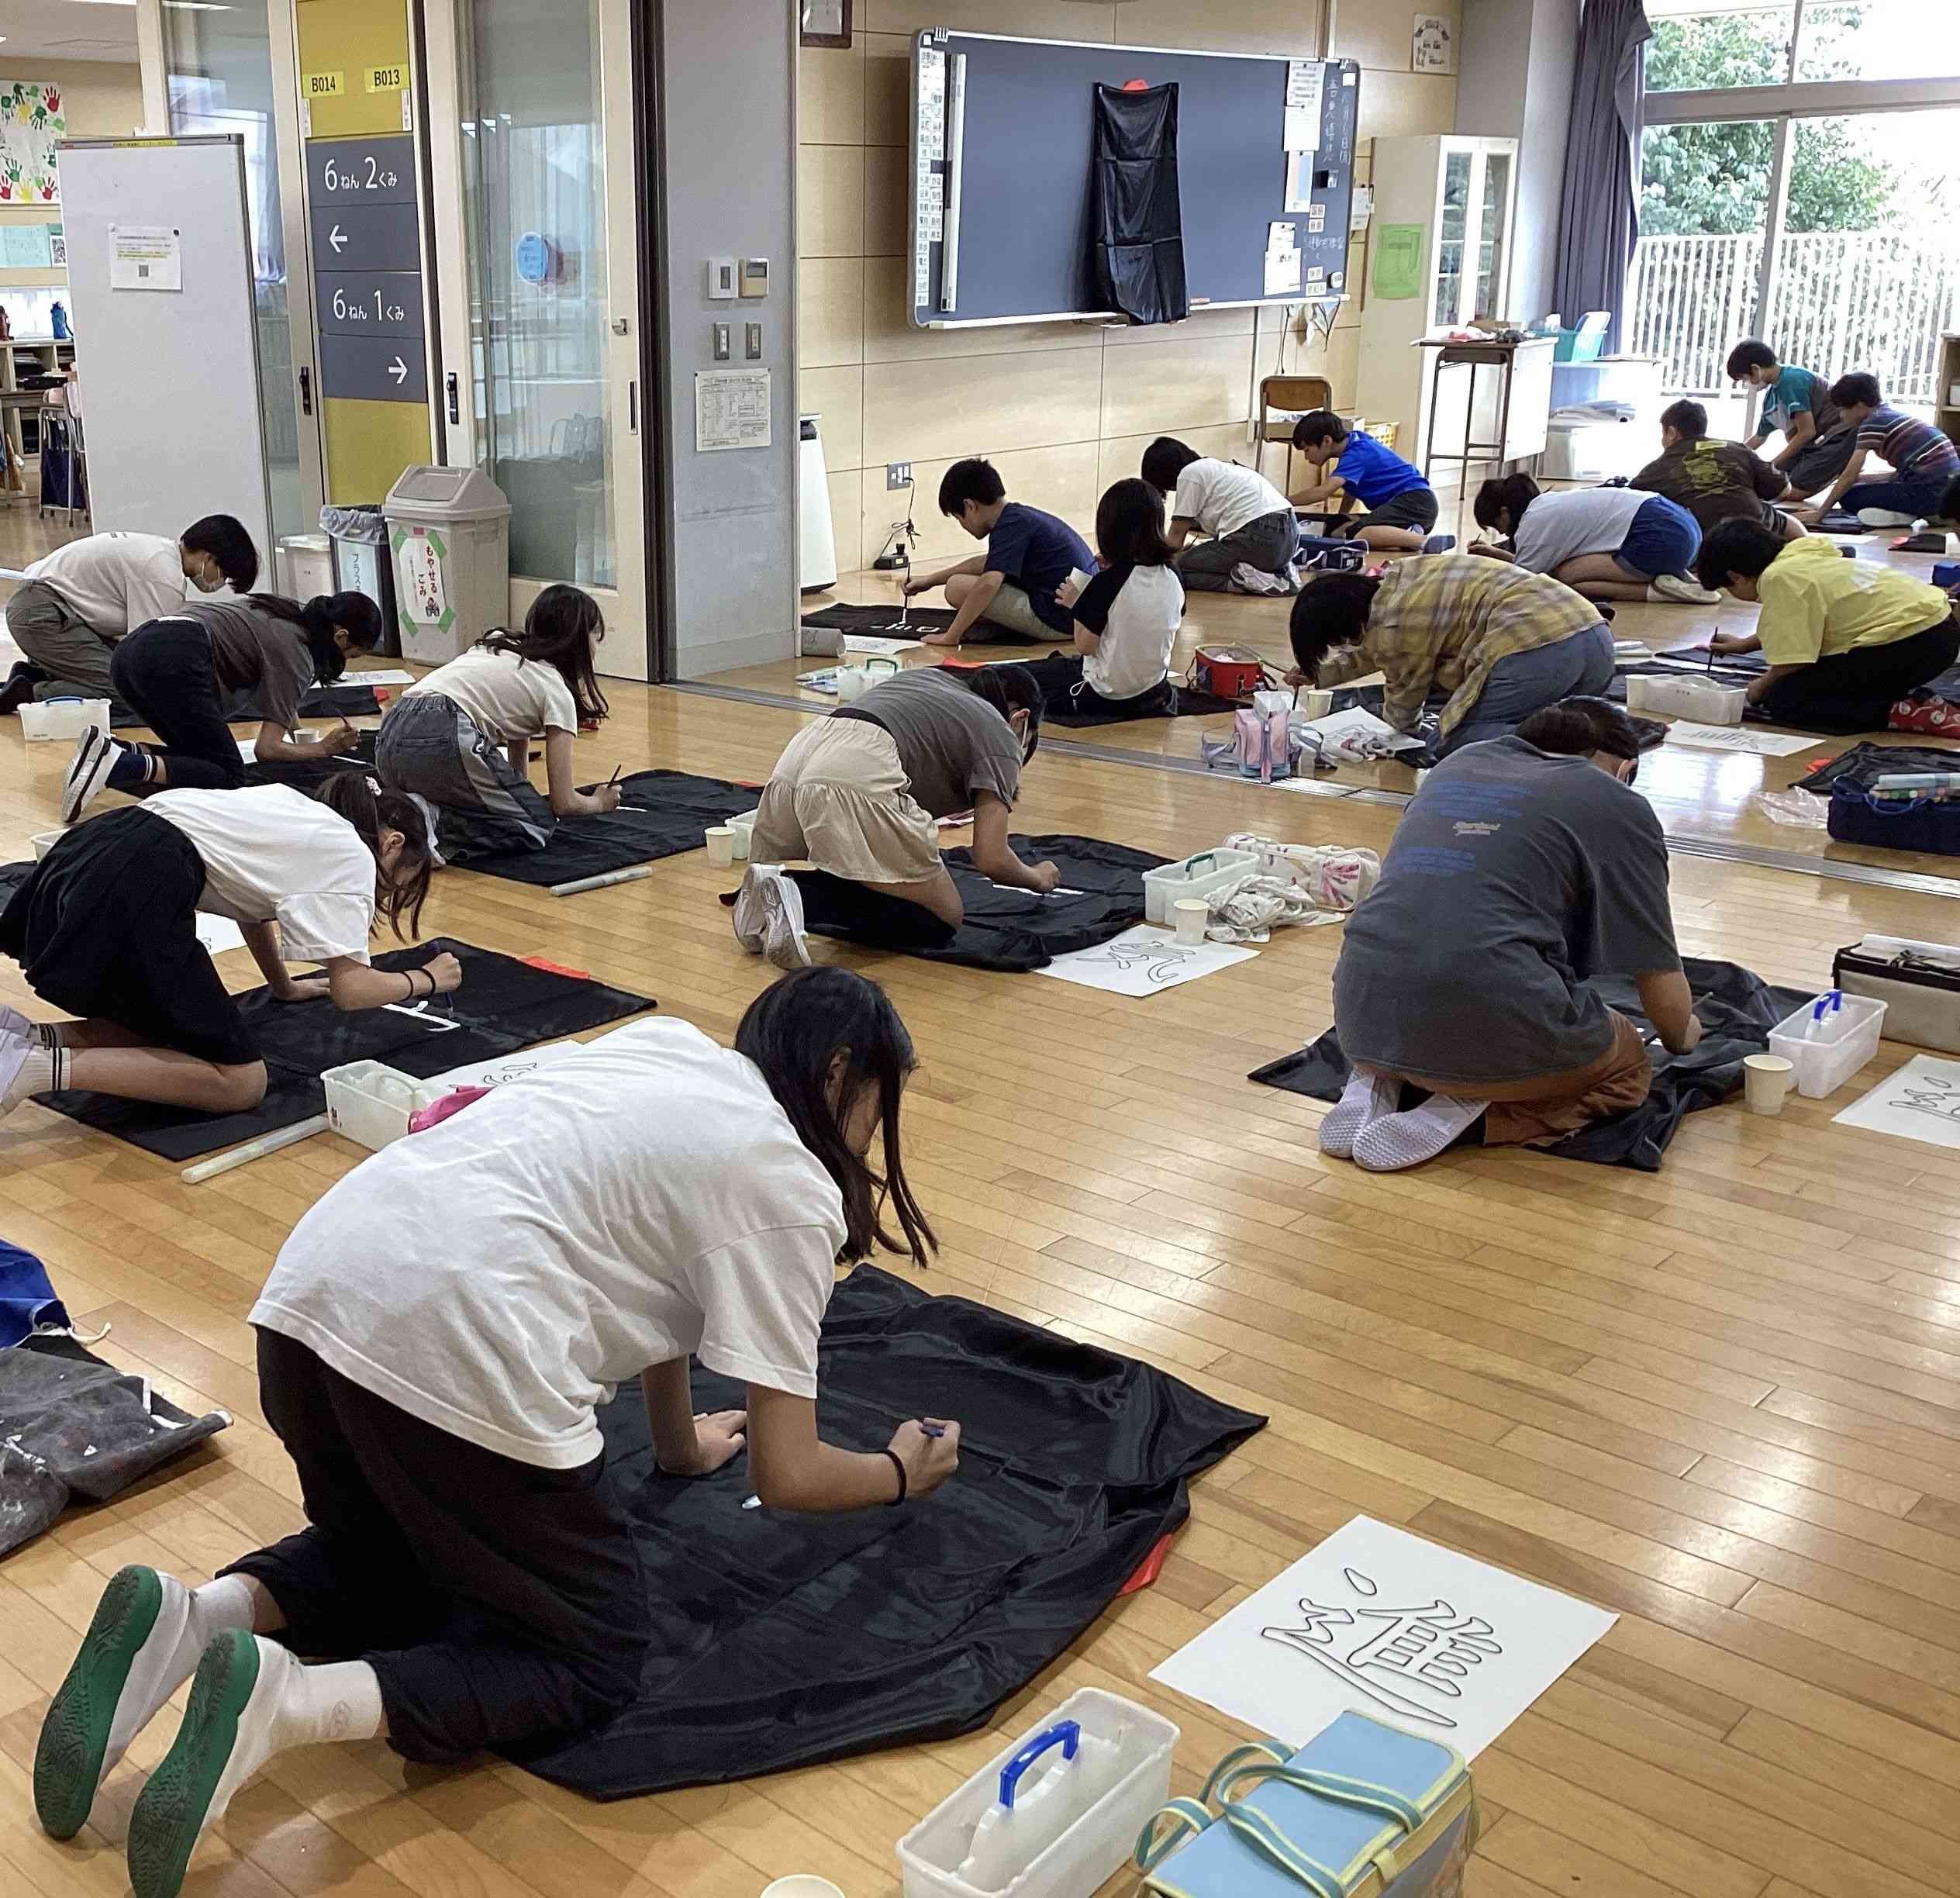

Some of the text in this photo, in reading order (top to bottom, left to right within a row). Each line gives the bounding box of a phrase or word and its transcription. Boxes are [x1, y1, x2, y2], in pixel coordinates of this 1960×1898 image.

[311, 76, 336, 92] B014
[374, 69, 401, 86] B013
[324, 156, 398, 191] 6ねん 2くみ
[333, 288, 405, 322] 6ねん 1くみ
[417, 573, 427, 596] ごみ
[425, 545, 438, 594] もやせる
[1260, 1566, 1503, 1728] 進
